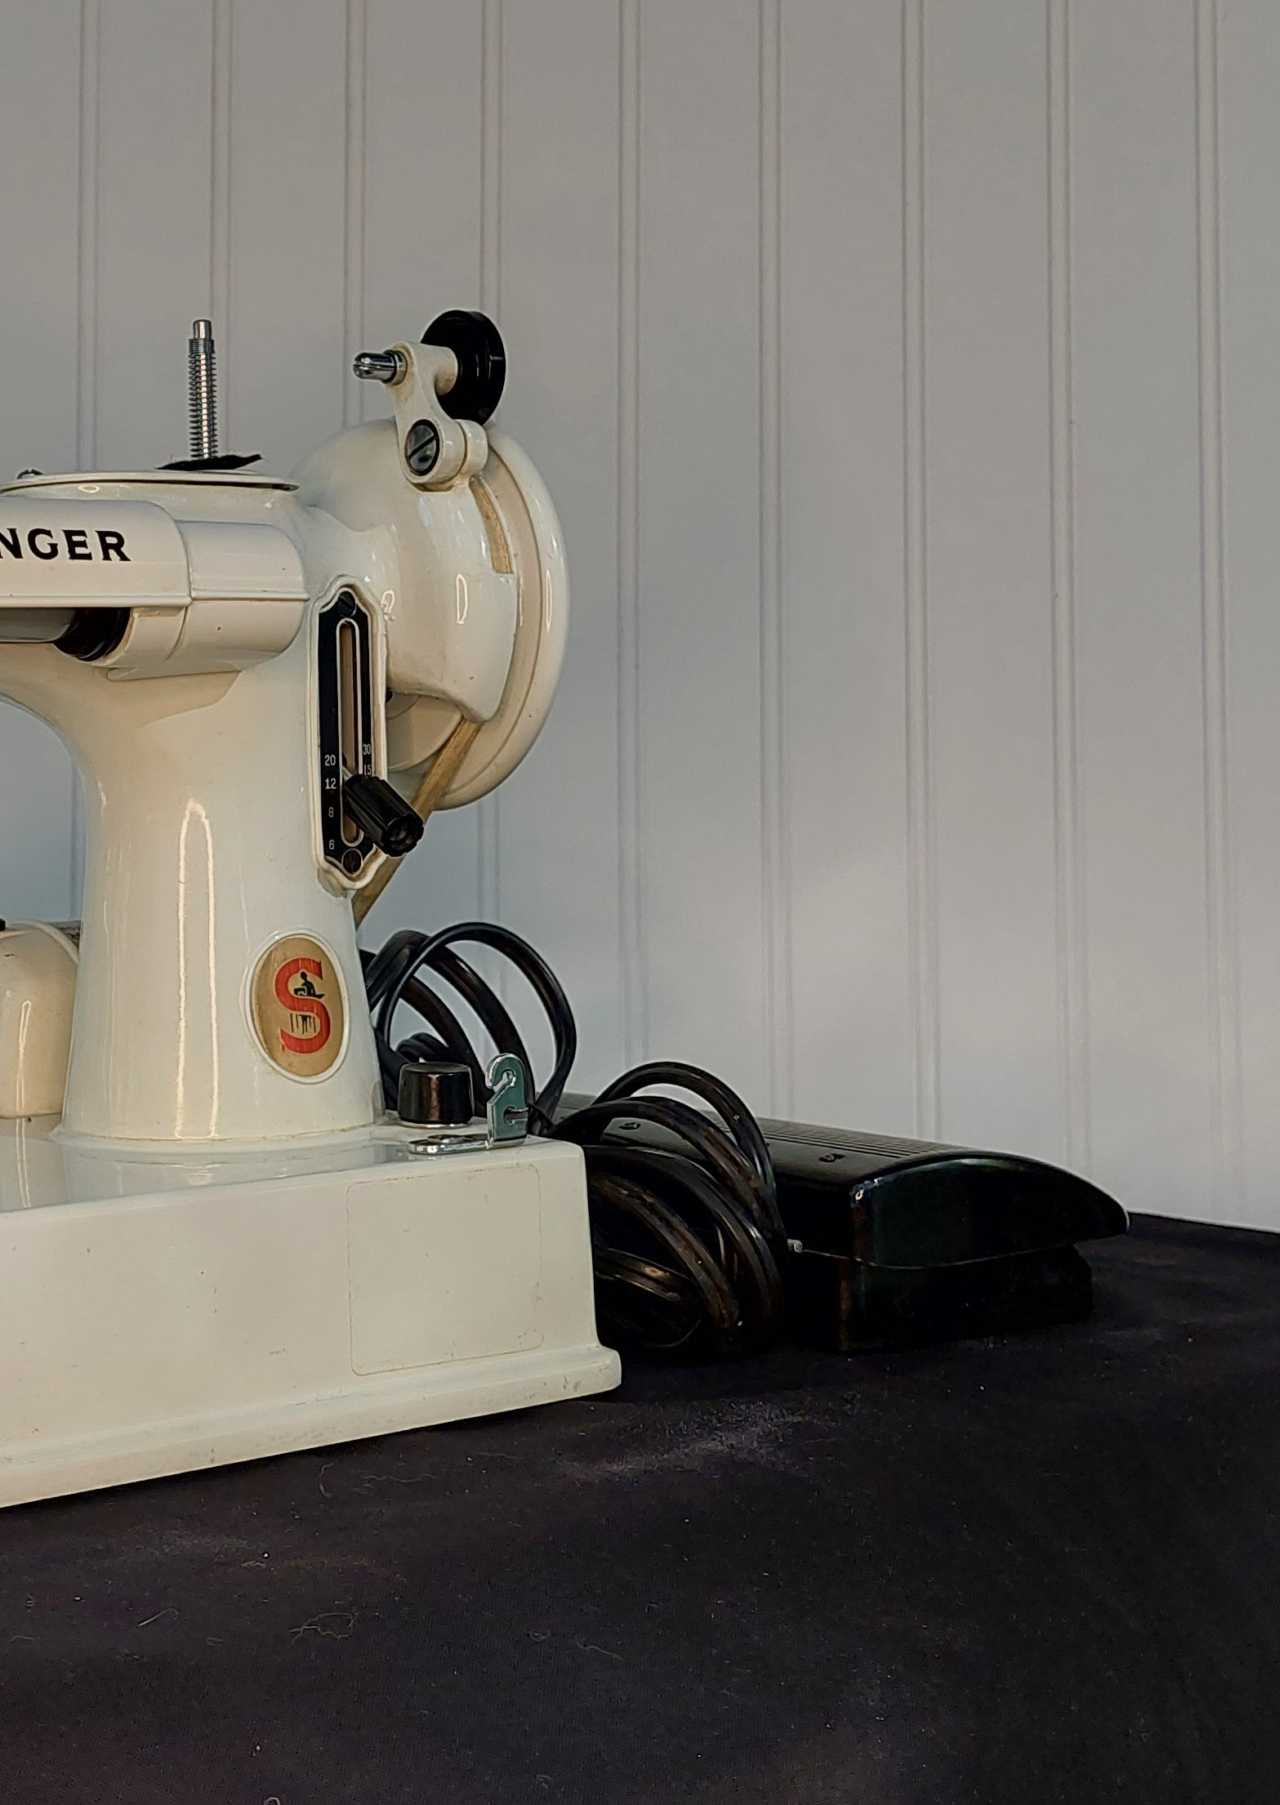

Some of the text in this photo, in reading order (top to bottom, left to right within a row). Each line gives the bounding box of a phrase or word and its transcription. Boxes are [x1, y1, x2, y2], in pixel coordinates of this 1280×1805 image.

[363, 743, 371, 755] 30
[324, 754, 336, 767] 20
[324, 778, 337, 790] 12
[328, 839, 335, 850] 6
[274, 957, 331, 1055] S
